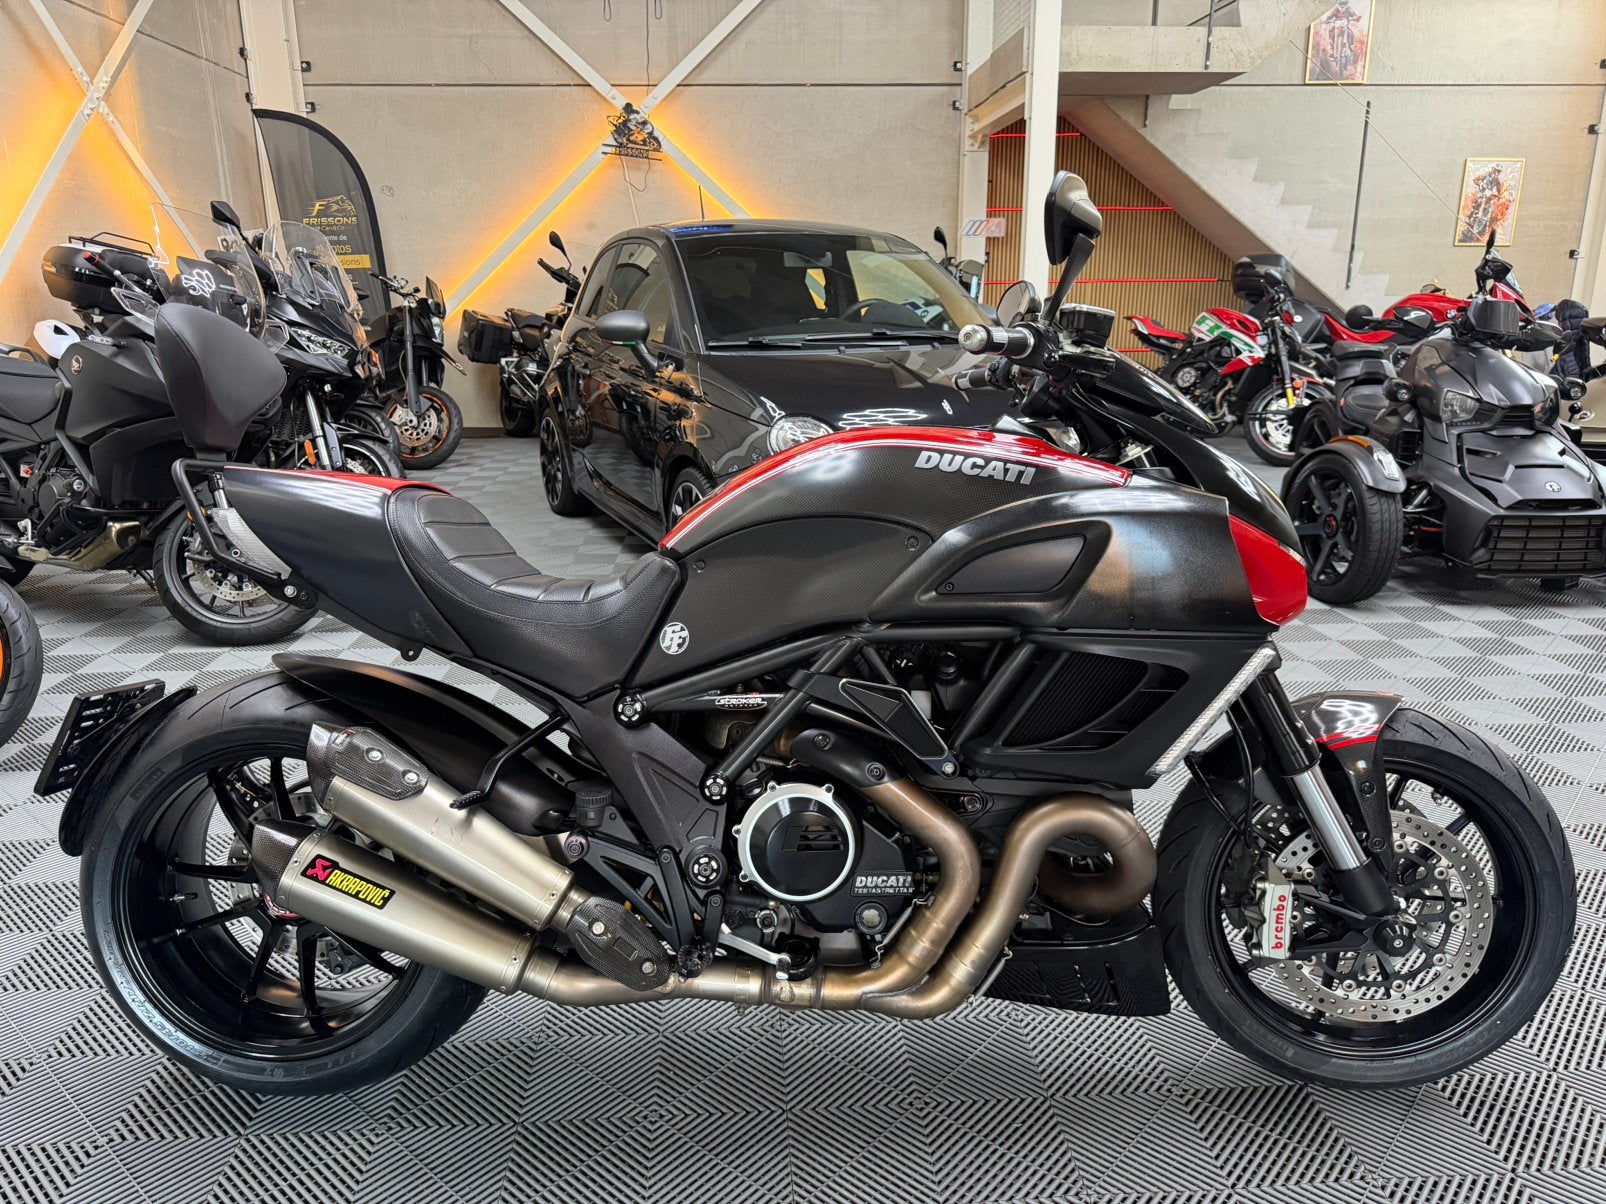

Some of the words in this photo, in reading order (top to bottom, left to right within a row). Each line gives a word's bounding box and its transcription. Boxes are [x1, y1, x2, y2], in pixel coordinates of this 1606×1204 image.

[303, 217, 357, 225] FRISSONS
[914, 450, 1037, 486] DUCATI
[855, 875, 912, 887] DUCATI
[1271, 895, 1287, 950] brembo
